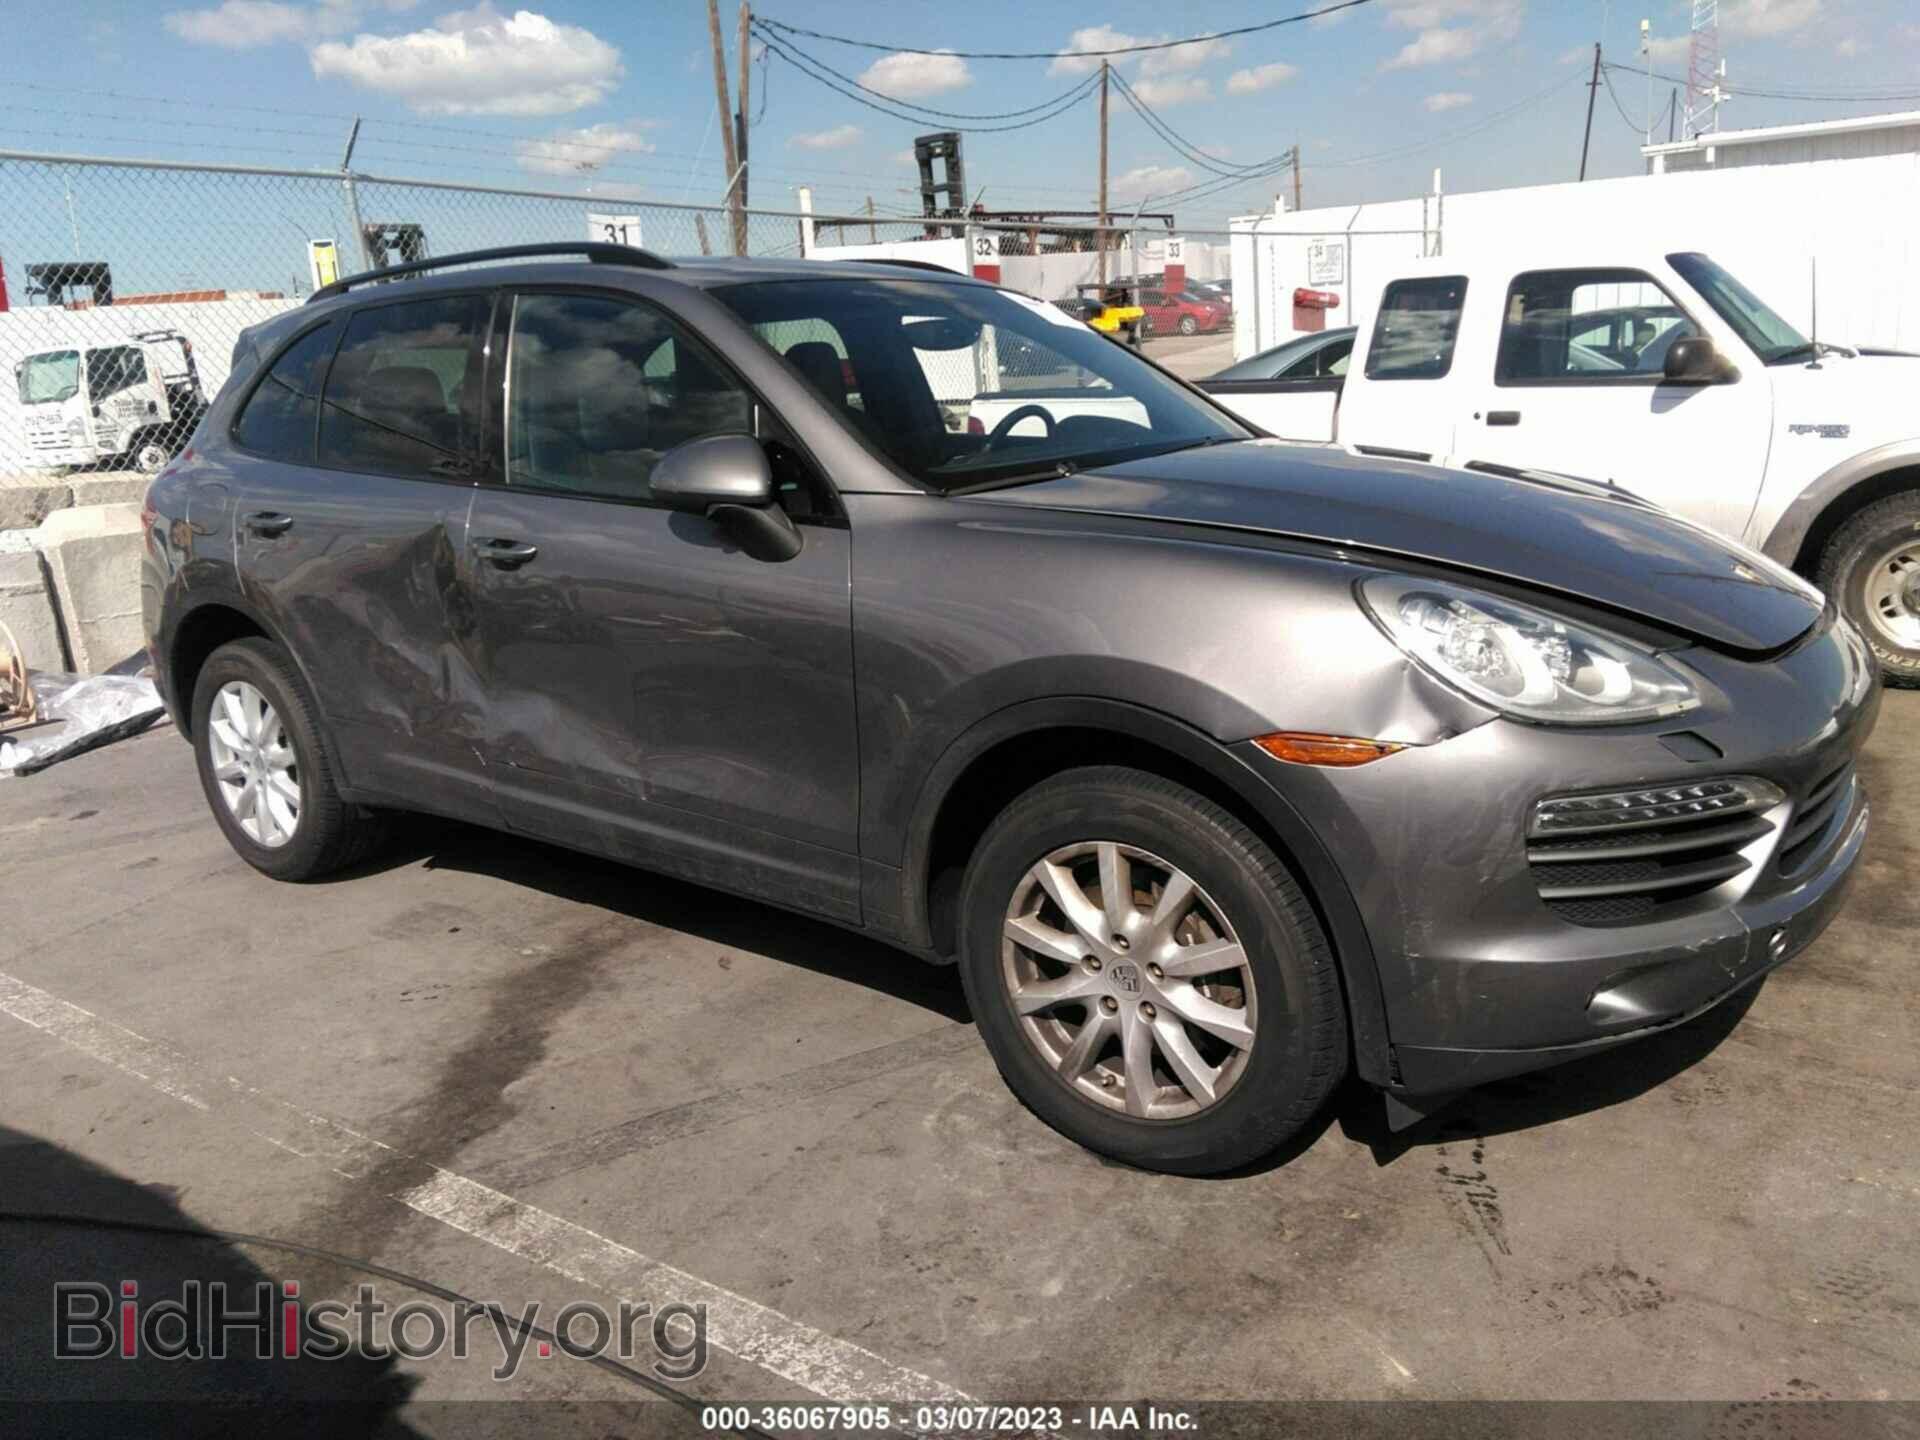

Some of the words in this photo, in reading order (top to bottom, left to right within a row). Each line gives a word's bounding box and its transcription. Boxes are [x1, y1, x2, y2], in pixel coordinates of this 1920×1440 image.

[603, 223, 628, 247] 31
[976, 238, 992, 256] 32
[1168, 242, 1181, 258] 33
